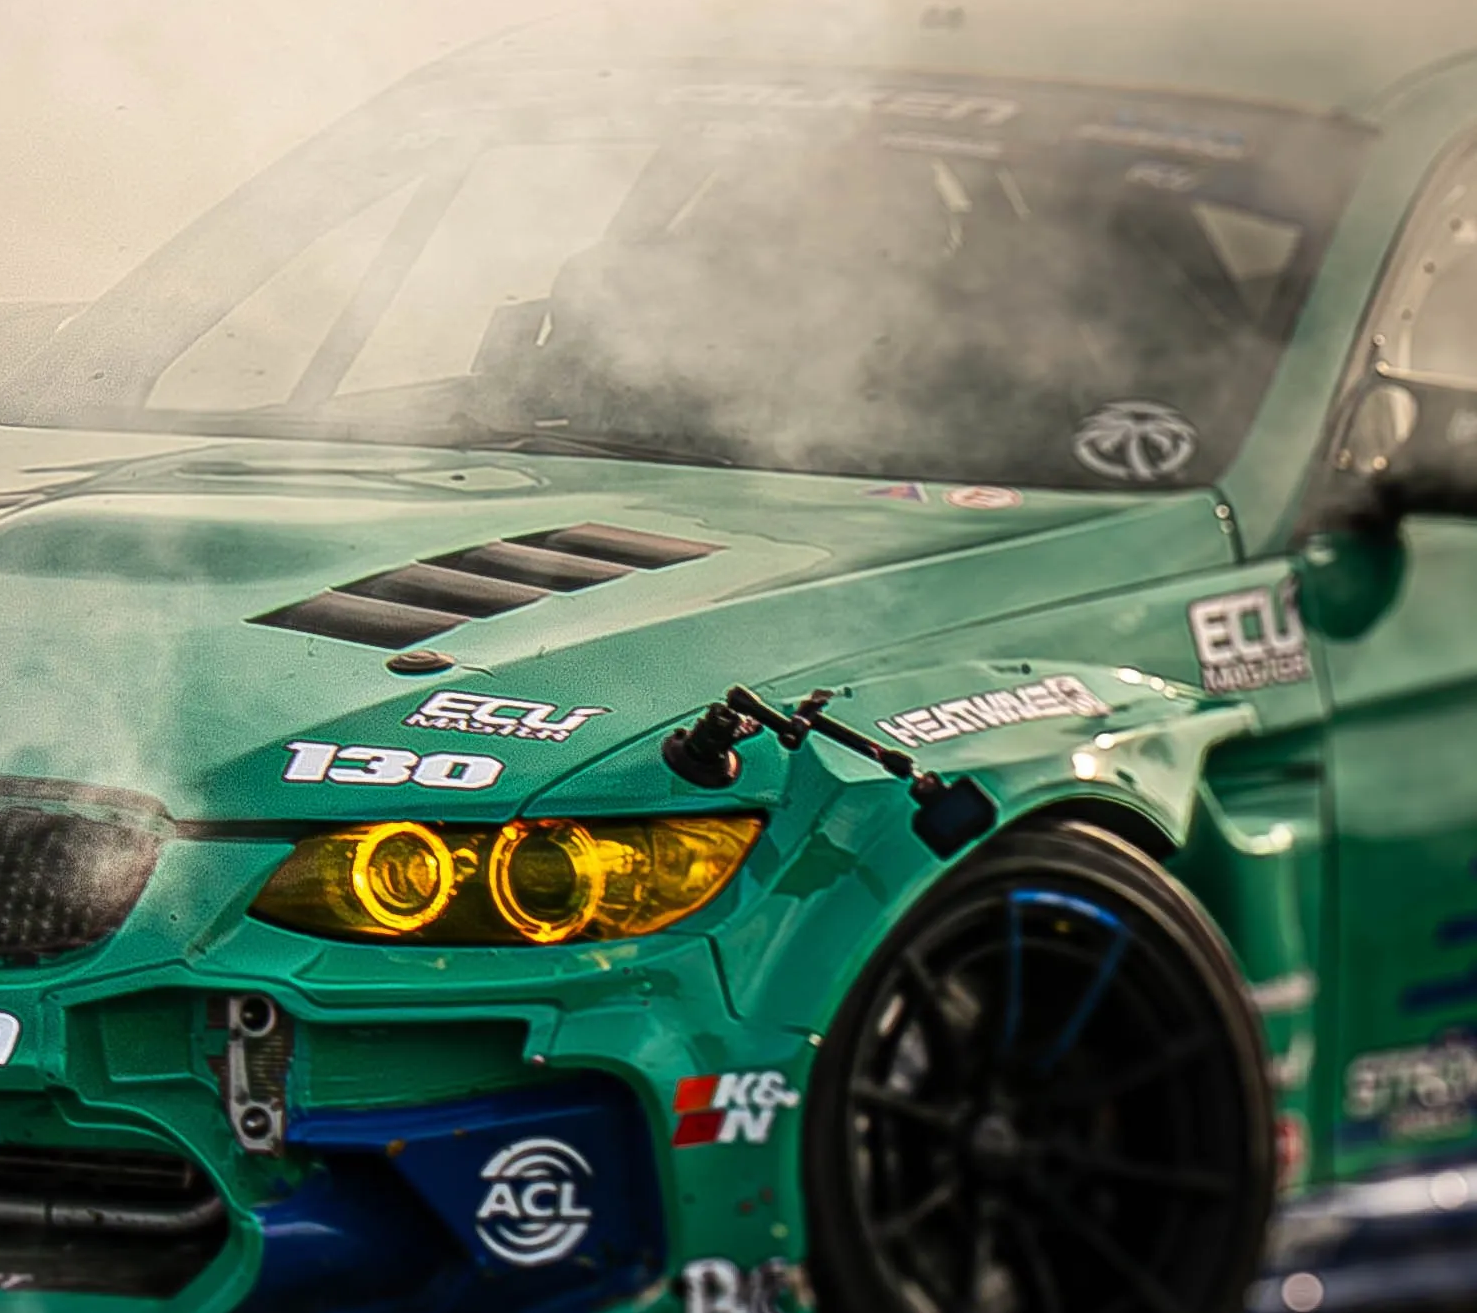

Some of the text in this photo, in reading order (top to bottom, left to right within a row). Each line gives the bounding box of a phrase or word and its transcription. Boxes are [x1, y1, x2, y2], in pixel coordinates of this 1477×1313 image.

[1190, 577, 1307, 665] ECU
[406, 712, 572, 744] MASTER
[420, 691, 609, 732] ECU
[284, 741, 505, 791] 130
[477, 1182, 594, 1219] ACL
